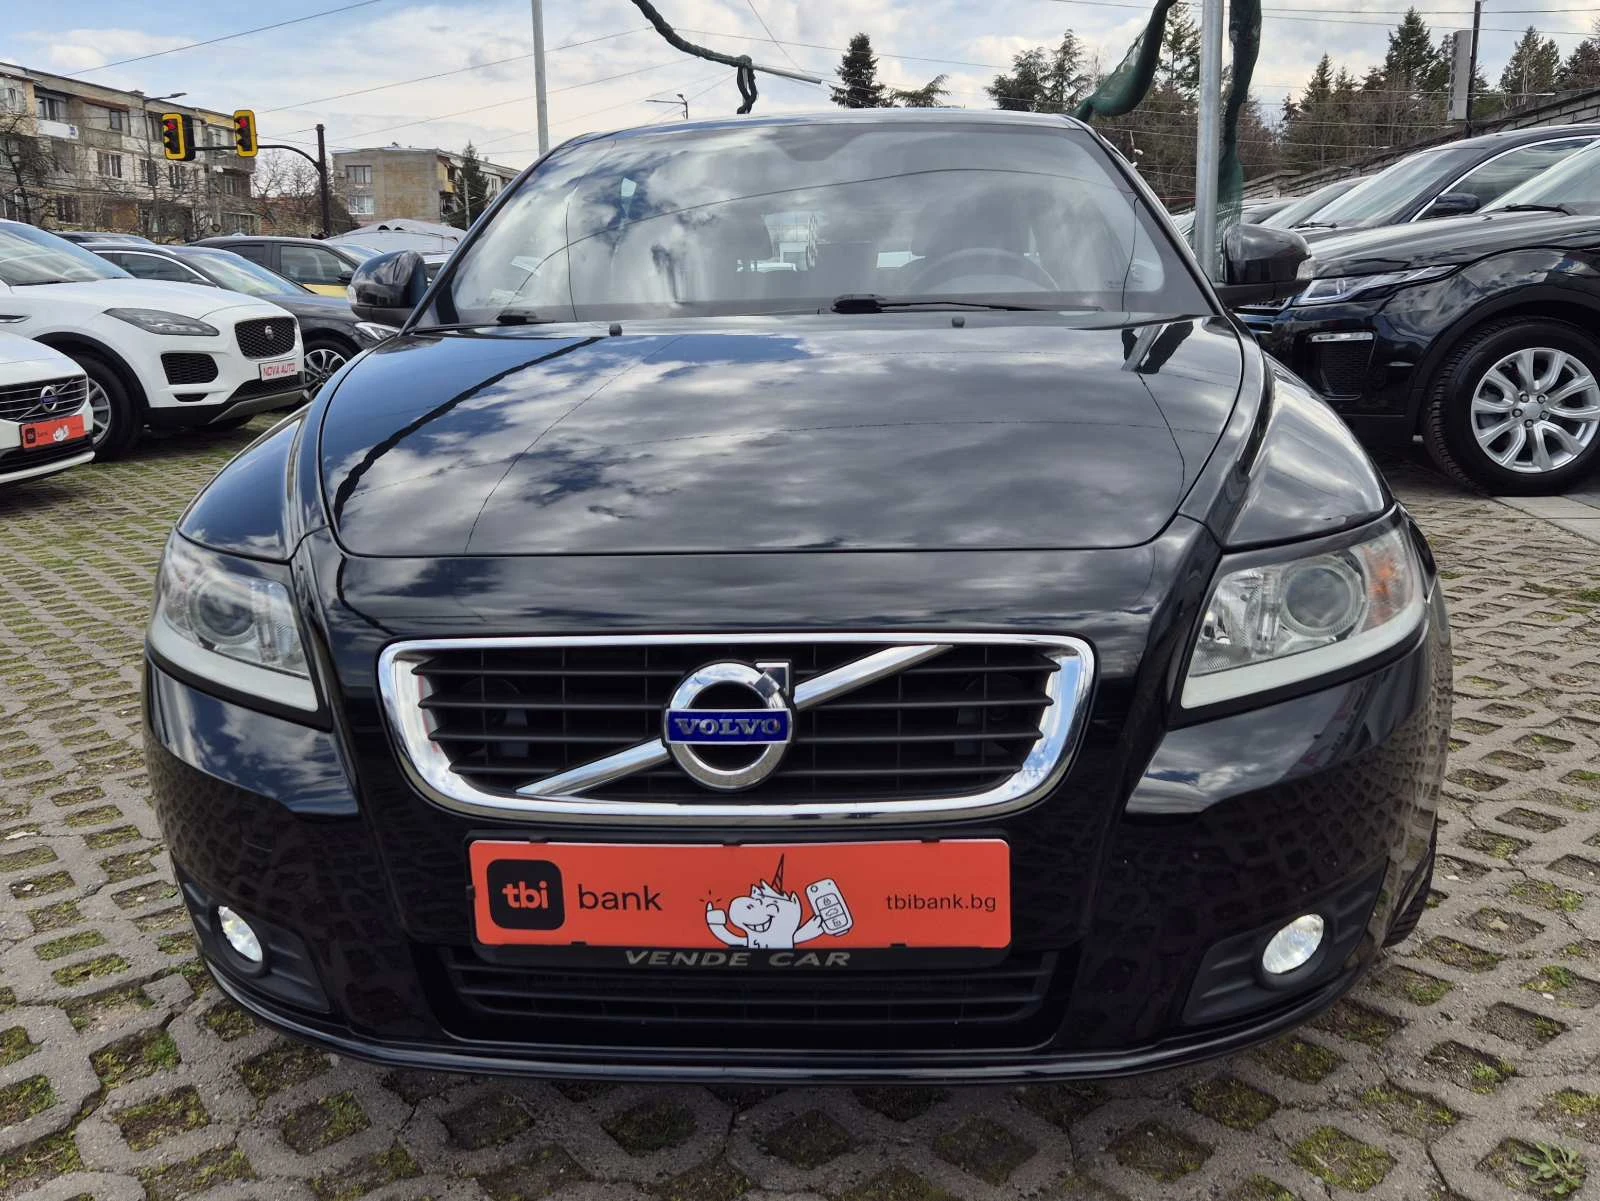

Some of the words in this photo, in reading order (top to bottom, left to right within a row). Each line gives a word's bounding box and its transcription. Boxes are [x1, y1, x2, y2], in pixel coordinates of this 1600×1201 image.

[263, 365, 280, 377] NOVA
[280, 362, 296, 374] AUTO
[674, 718, 781, 735] VOLVO
[502, 880, 549, 909] tbi
[577, 884, 663, 911] bank
[886, 894, 996, 912] tbibank.bg
[625, 950, 750, 966] VENDE
[768, 952, 851, 967] CAR
